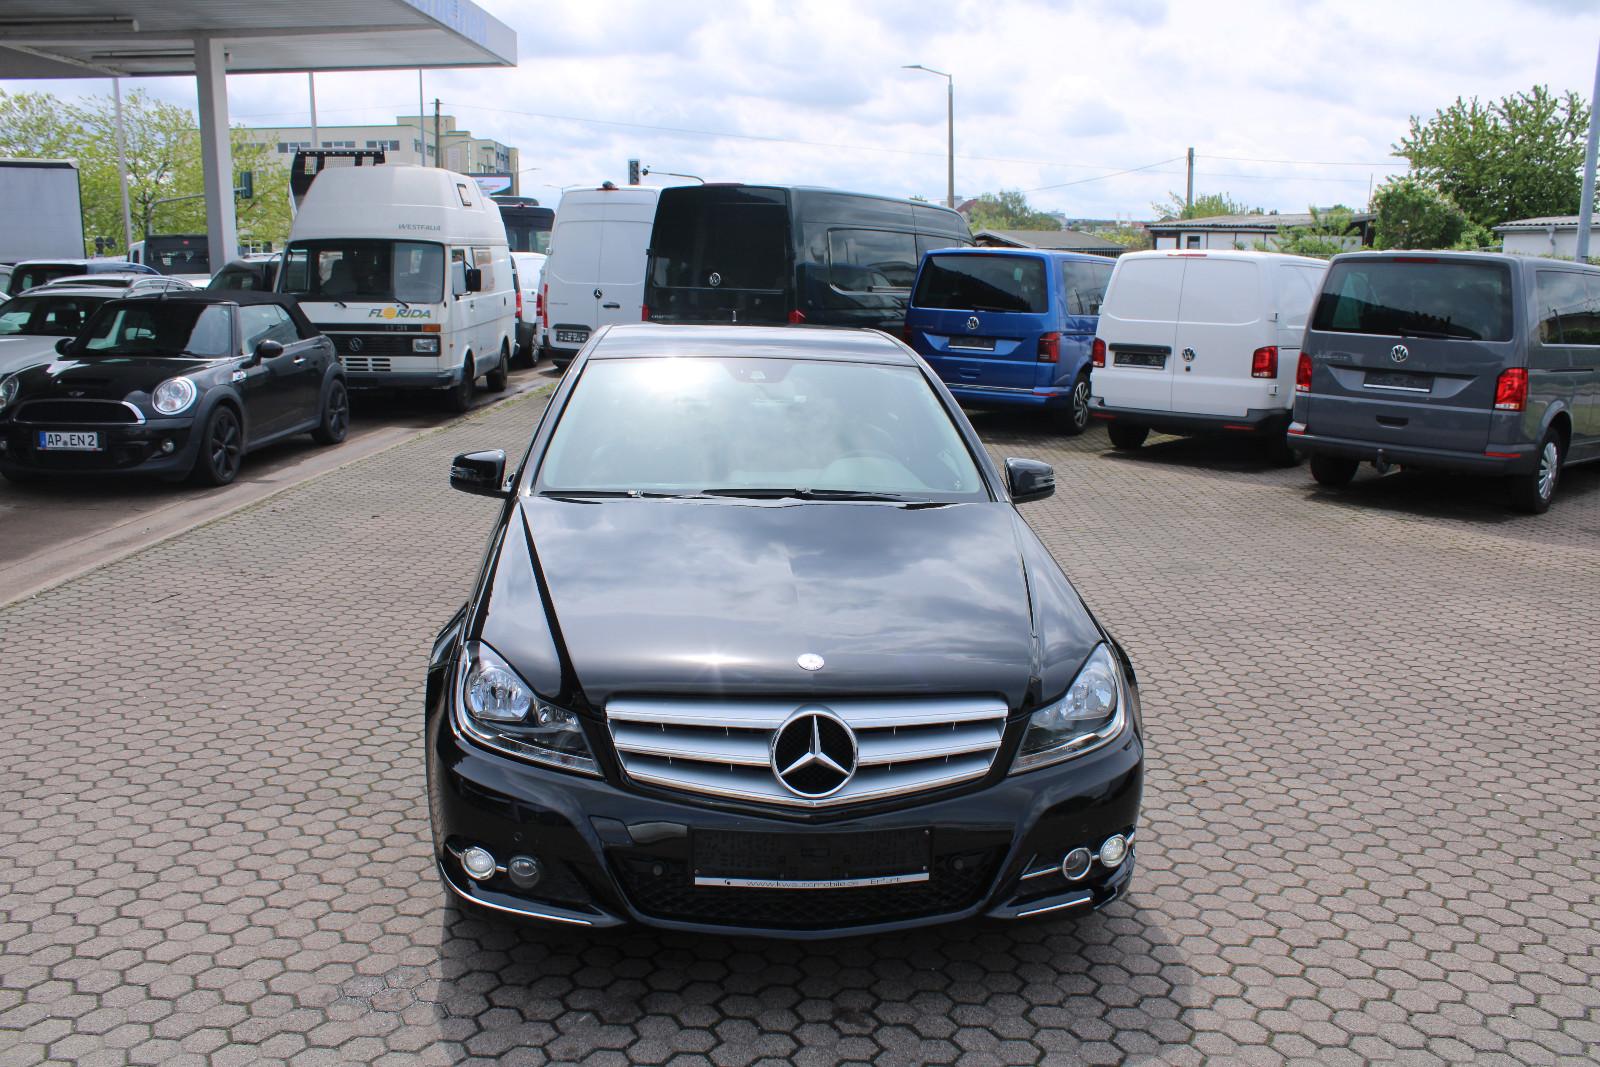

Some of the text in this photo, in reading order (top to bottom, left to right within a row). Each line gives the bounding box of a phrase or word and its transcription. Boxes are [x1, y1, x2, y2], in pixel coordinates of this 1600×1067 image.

[368, 306, 432, 319] FLORIDA
[47, 434, 95, 447] AP EN 2
